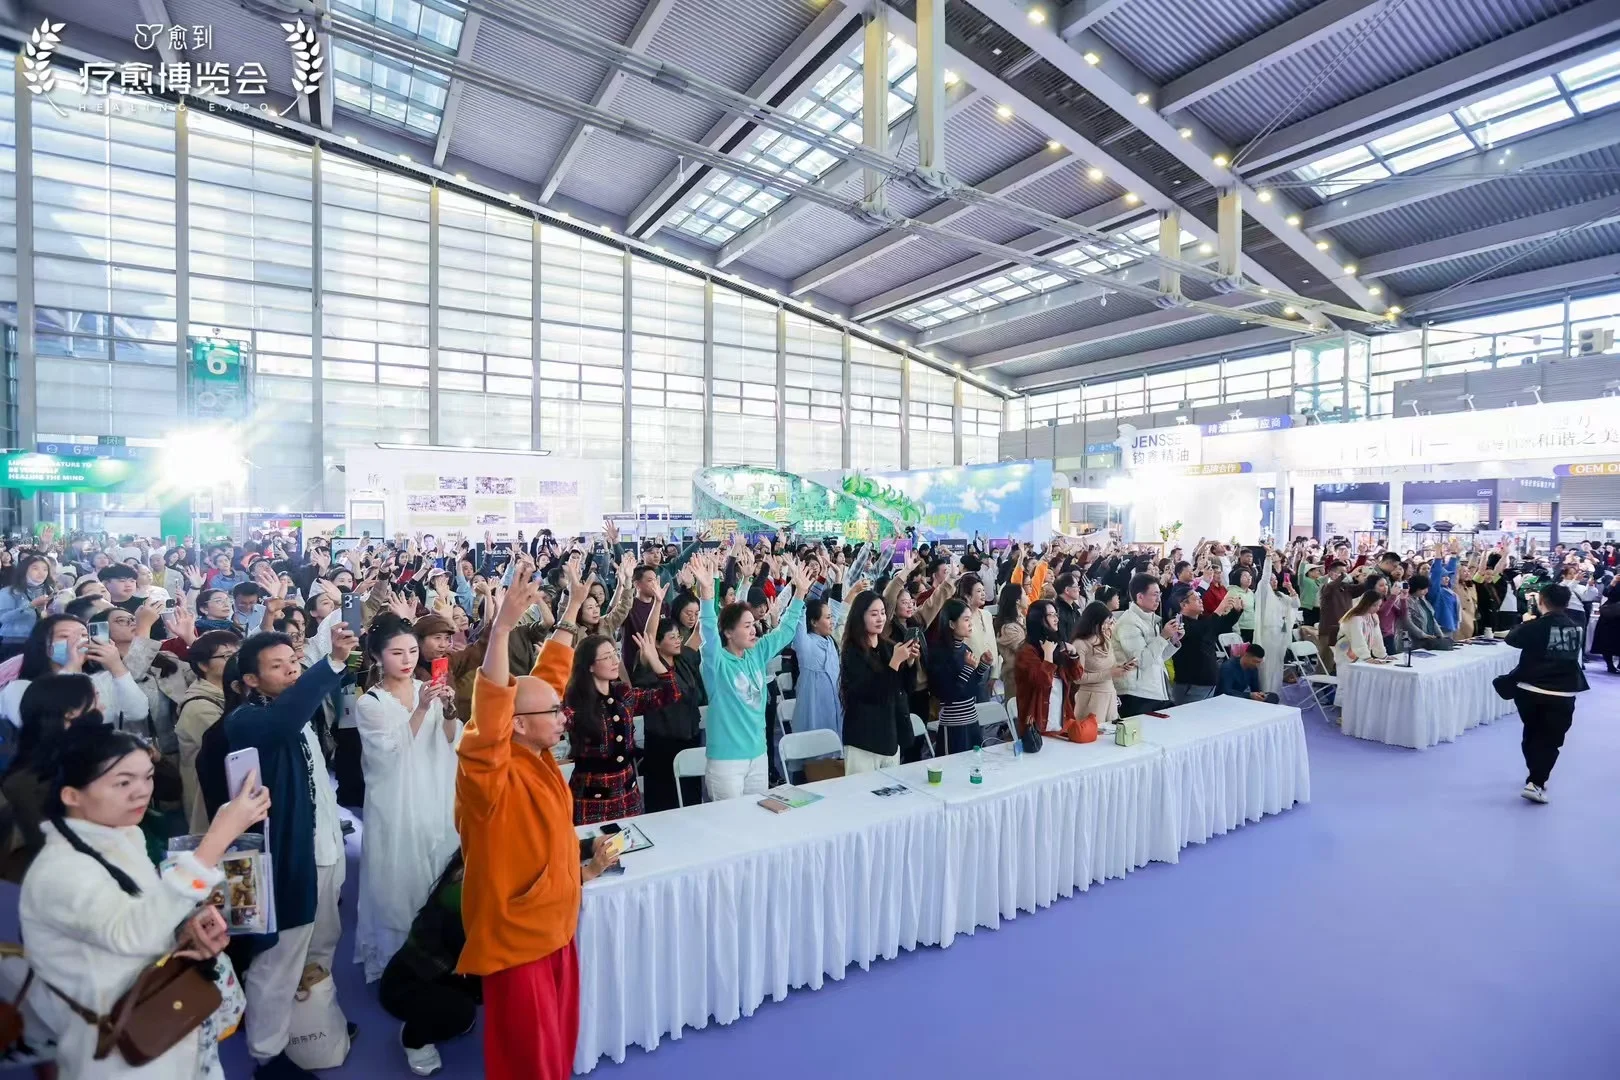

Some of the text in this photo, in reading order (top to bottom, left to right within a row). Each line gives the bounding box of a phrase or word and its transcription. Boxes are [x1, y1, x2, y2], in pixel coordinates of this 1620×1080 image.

[207, 348, 227, 375] 6
[1575, 463, 1620, 473] OEM O
